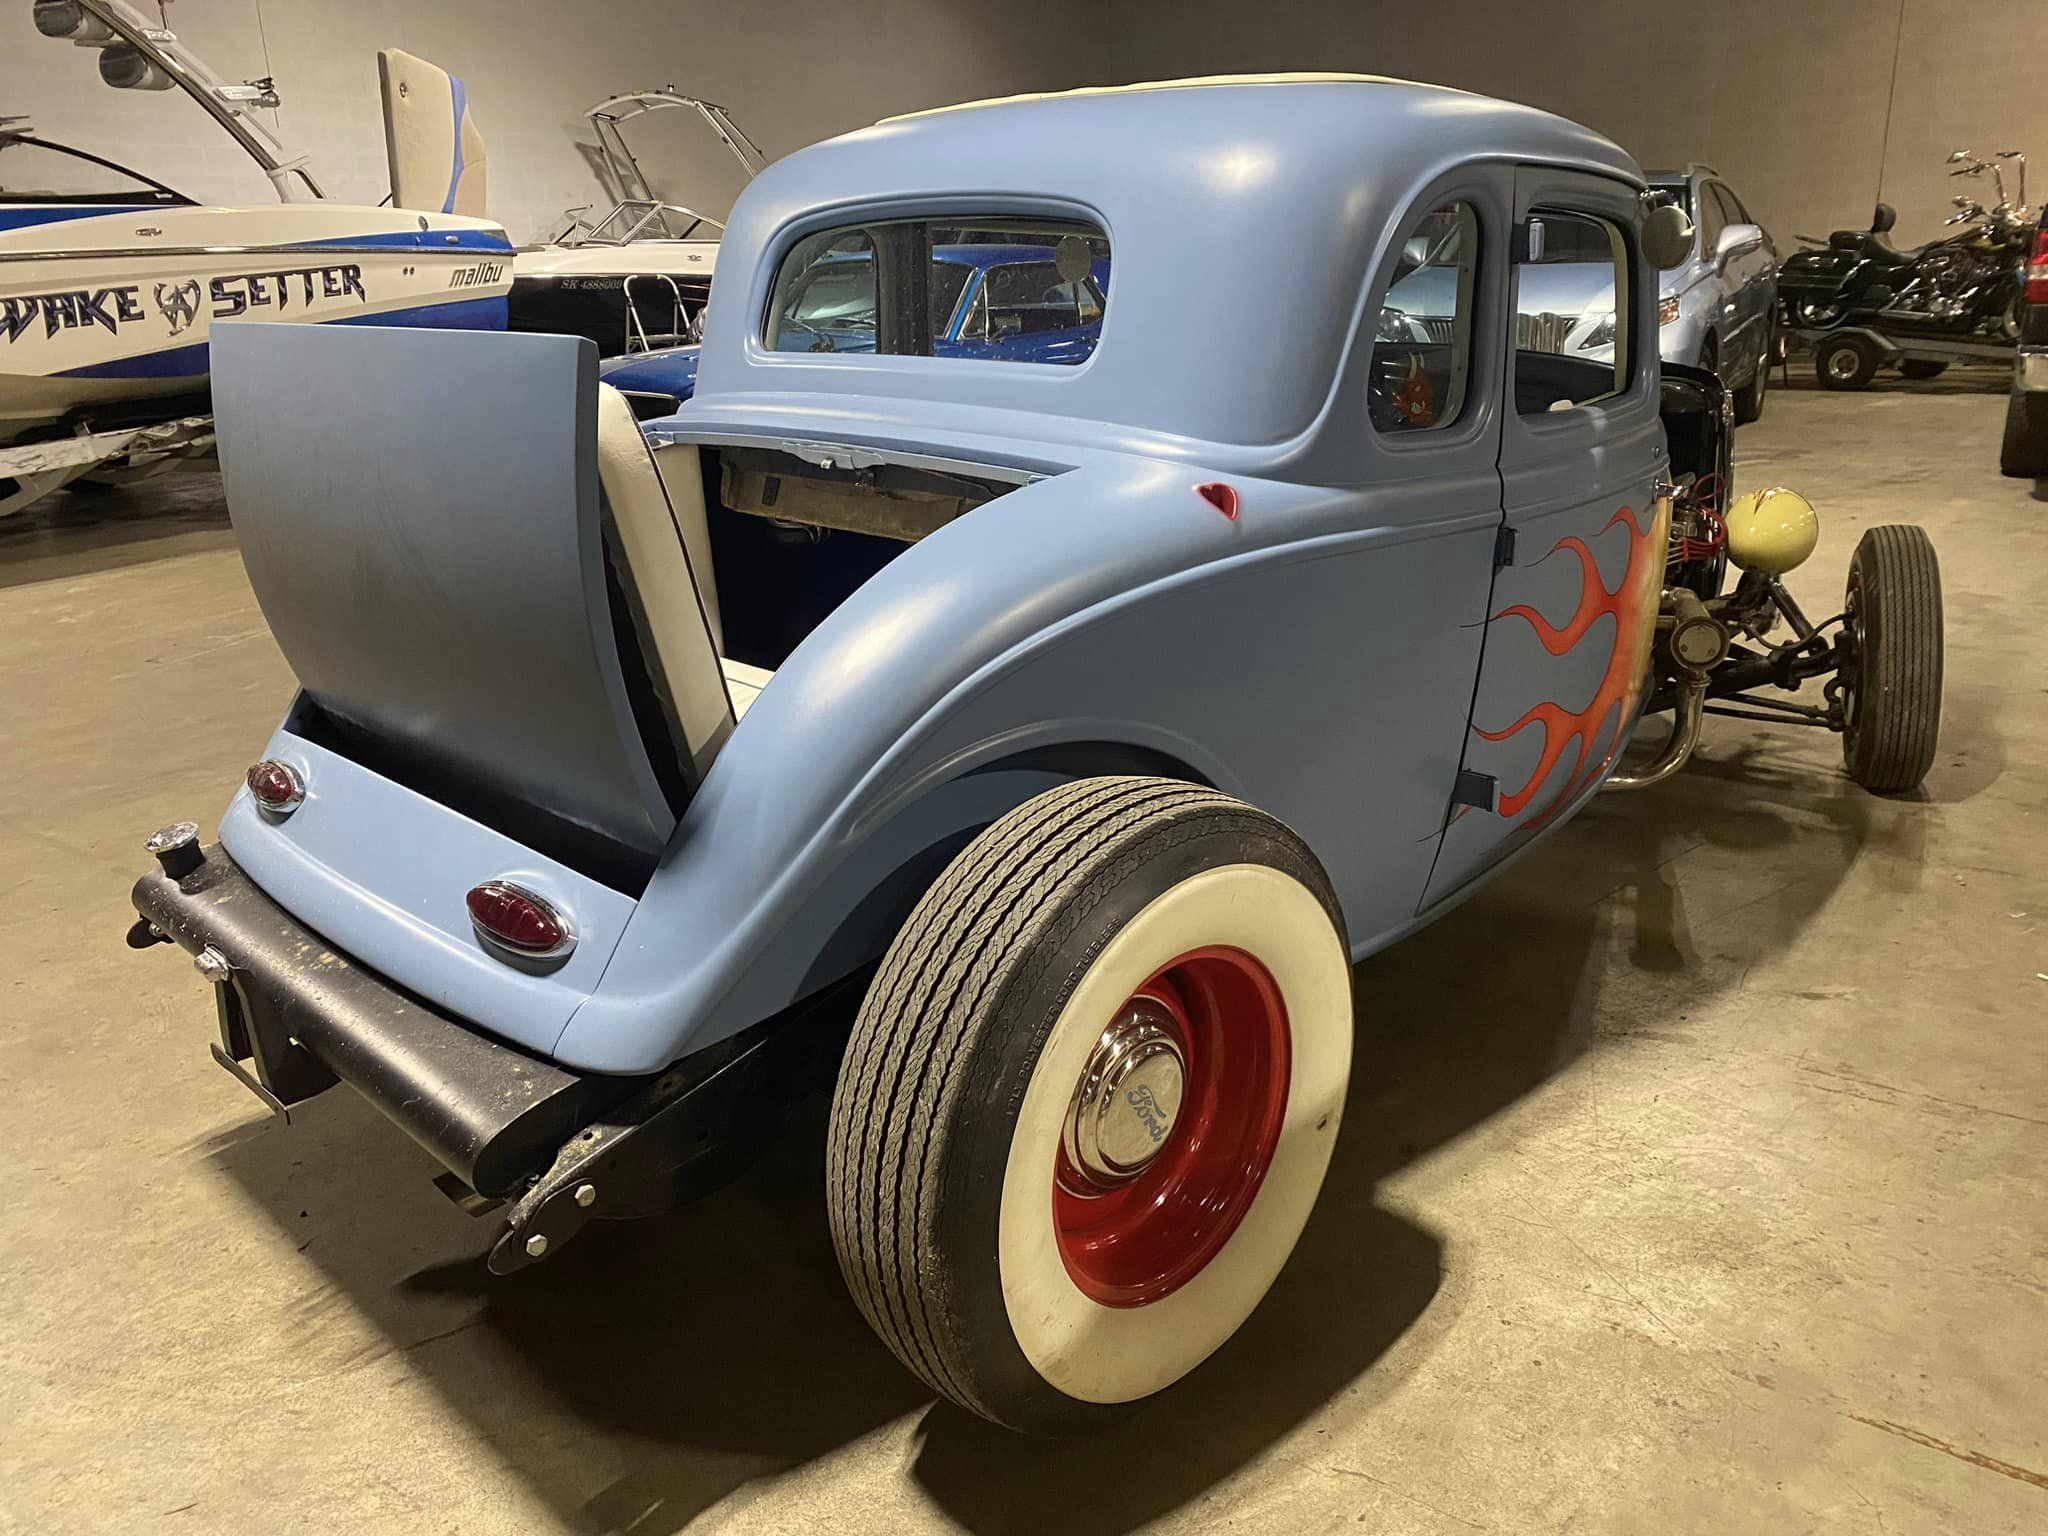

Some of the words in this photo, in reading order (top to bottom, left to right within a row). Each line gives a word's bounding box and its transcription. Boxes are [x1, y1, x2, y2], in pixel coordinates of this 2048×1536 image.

[209, 264, 366, 318] SETTER
[449, 262, 503, 287] malibu
[560, 279, 579, 290] SK
[1018, 1005, 1057, 1078] POLYESTER
[1056, 971, 1078, 1004] CORD
[1075, 918, 1121, 970] TUBELESS
[1126, 1084, 1168, 1142] Ford
